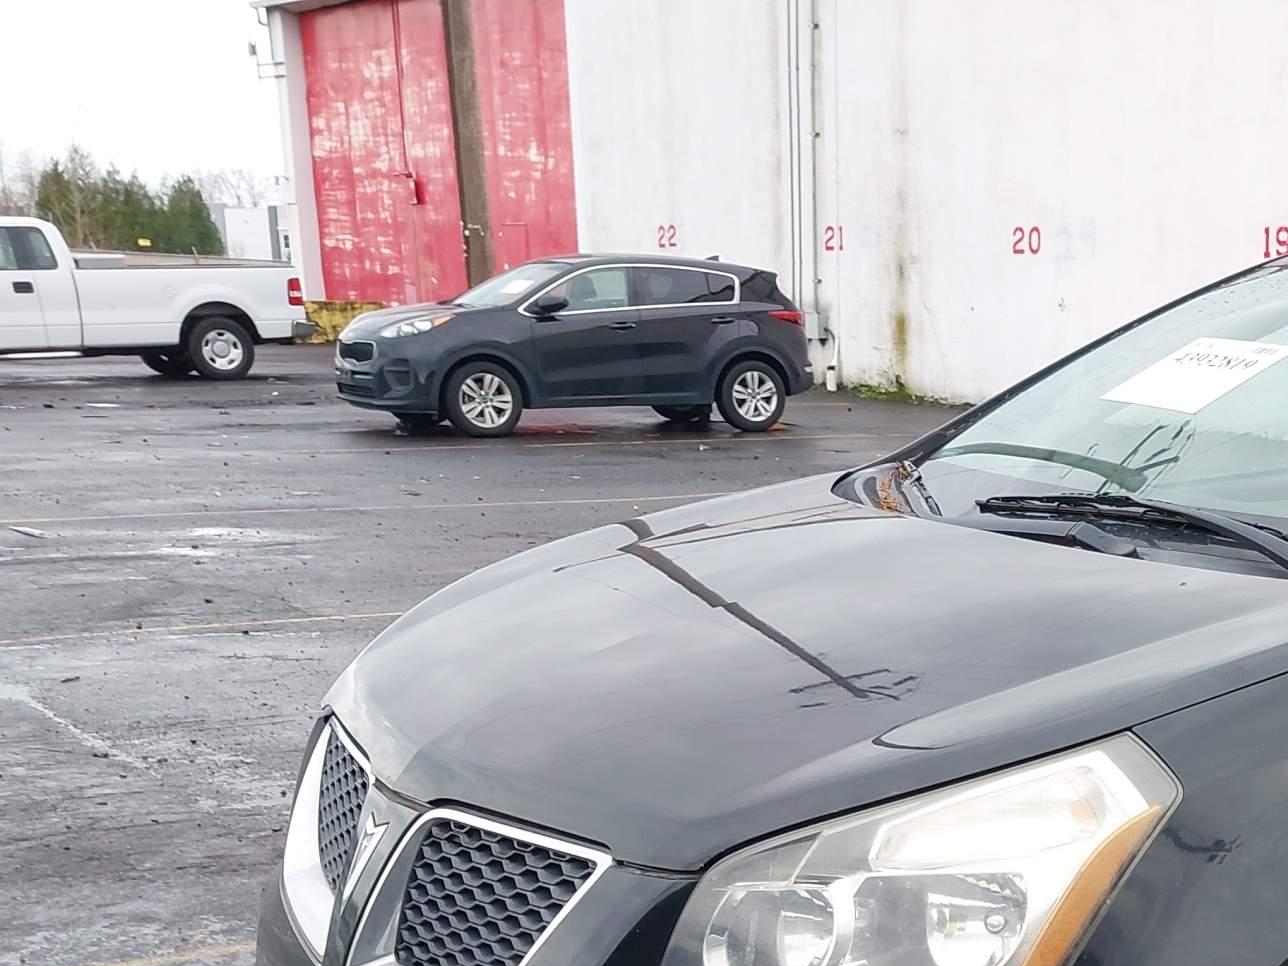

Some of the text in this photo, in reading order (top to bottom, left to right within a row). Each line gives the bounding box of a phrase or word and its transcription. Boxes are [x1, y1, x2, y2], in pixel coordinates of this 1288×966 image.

[657, 224, 677, 248] 22
[824, 225, 845, 251] 21
[1012, 225, 1041, 255] 20
